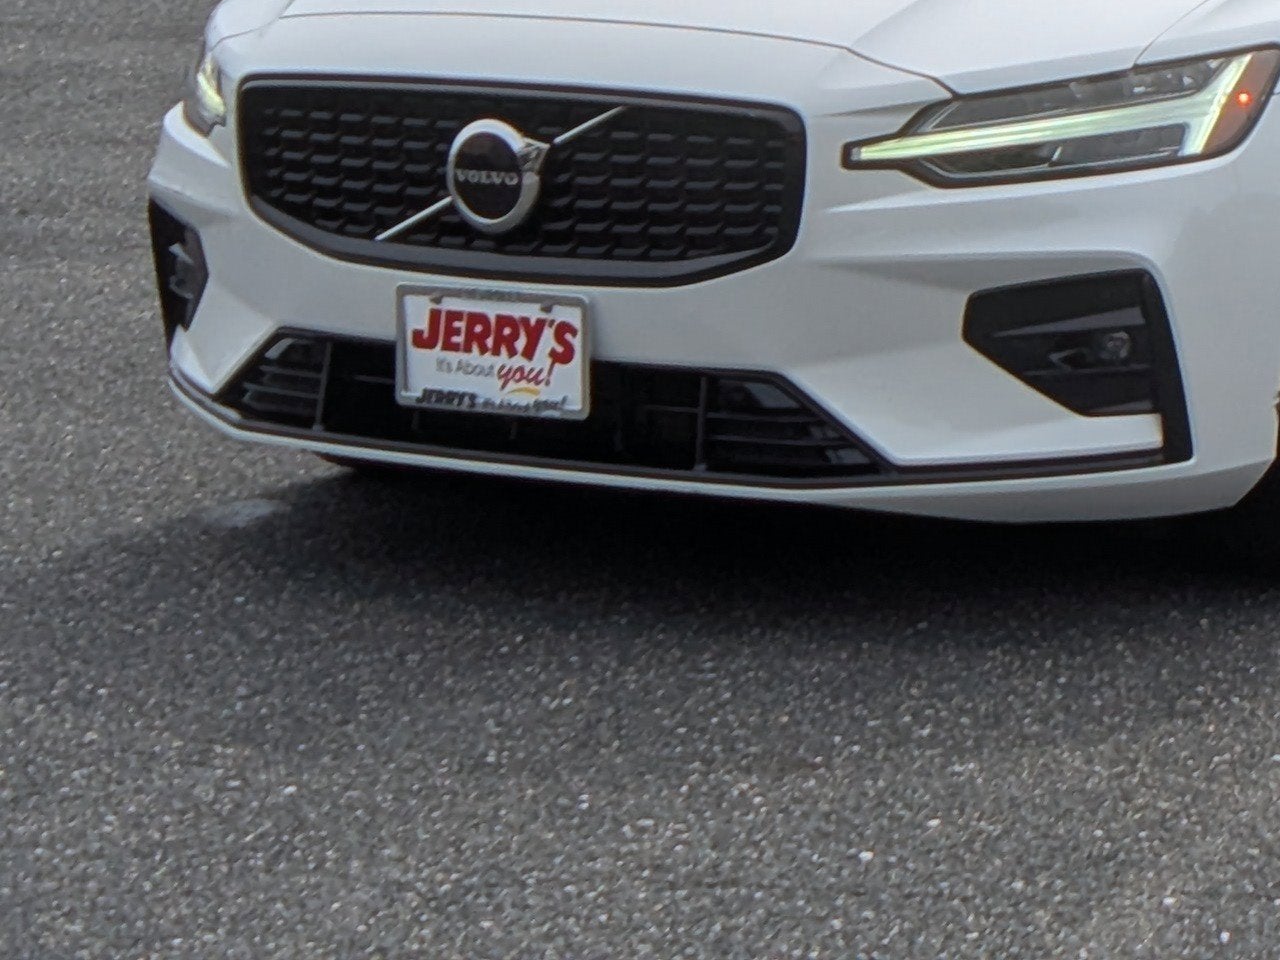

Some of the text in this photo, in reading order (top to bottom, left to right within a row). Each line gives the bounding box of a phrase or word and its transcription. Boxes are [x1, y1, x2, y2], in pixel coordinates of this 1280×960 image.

[455, 168, 519, 186] VOLVO
[412, 307, 578, 365] JERRY'S
[497, 361, 556, 390] you!
